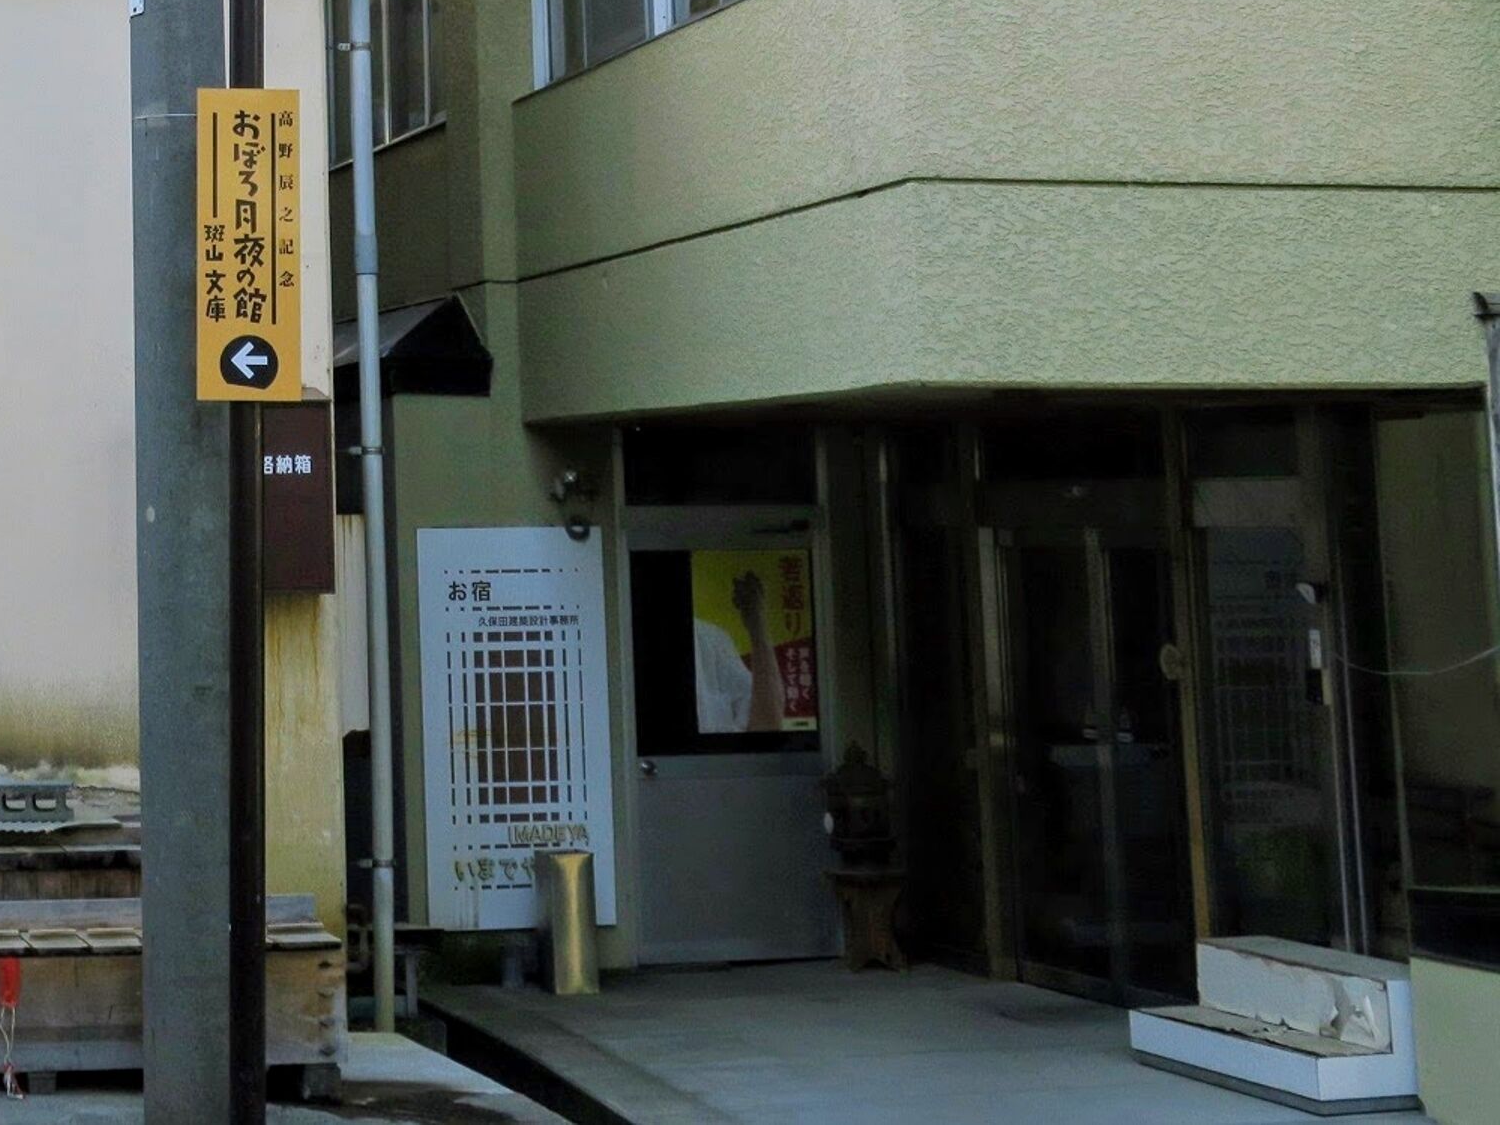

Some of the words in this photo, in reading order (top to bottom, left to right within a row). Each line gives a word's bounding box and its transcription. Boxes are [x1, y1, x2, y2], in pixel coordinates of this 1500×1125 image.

[232, 109, 267, 323] おぼろ月夜の館
[278, 111, 294, 288] 高野辰之記念
[204, 224, 227, 323] 斑山文庫
[448, 580, 491, 602] お宿
[507, 823, 590, 846] IMADEYA
